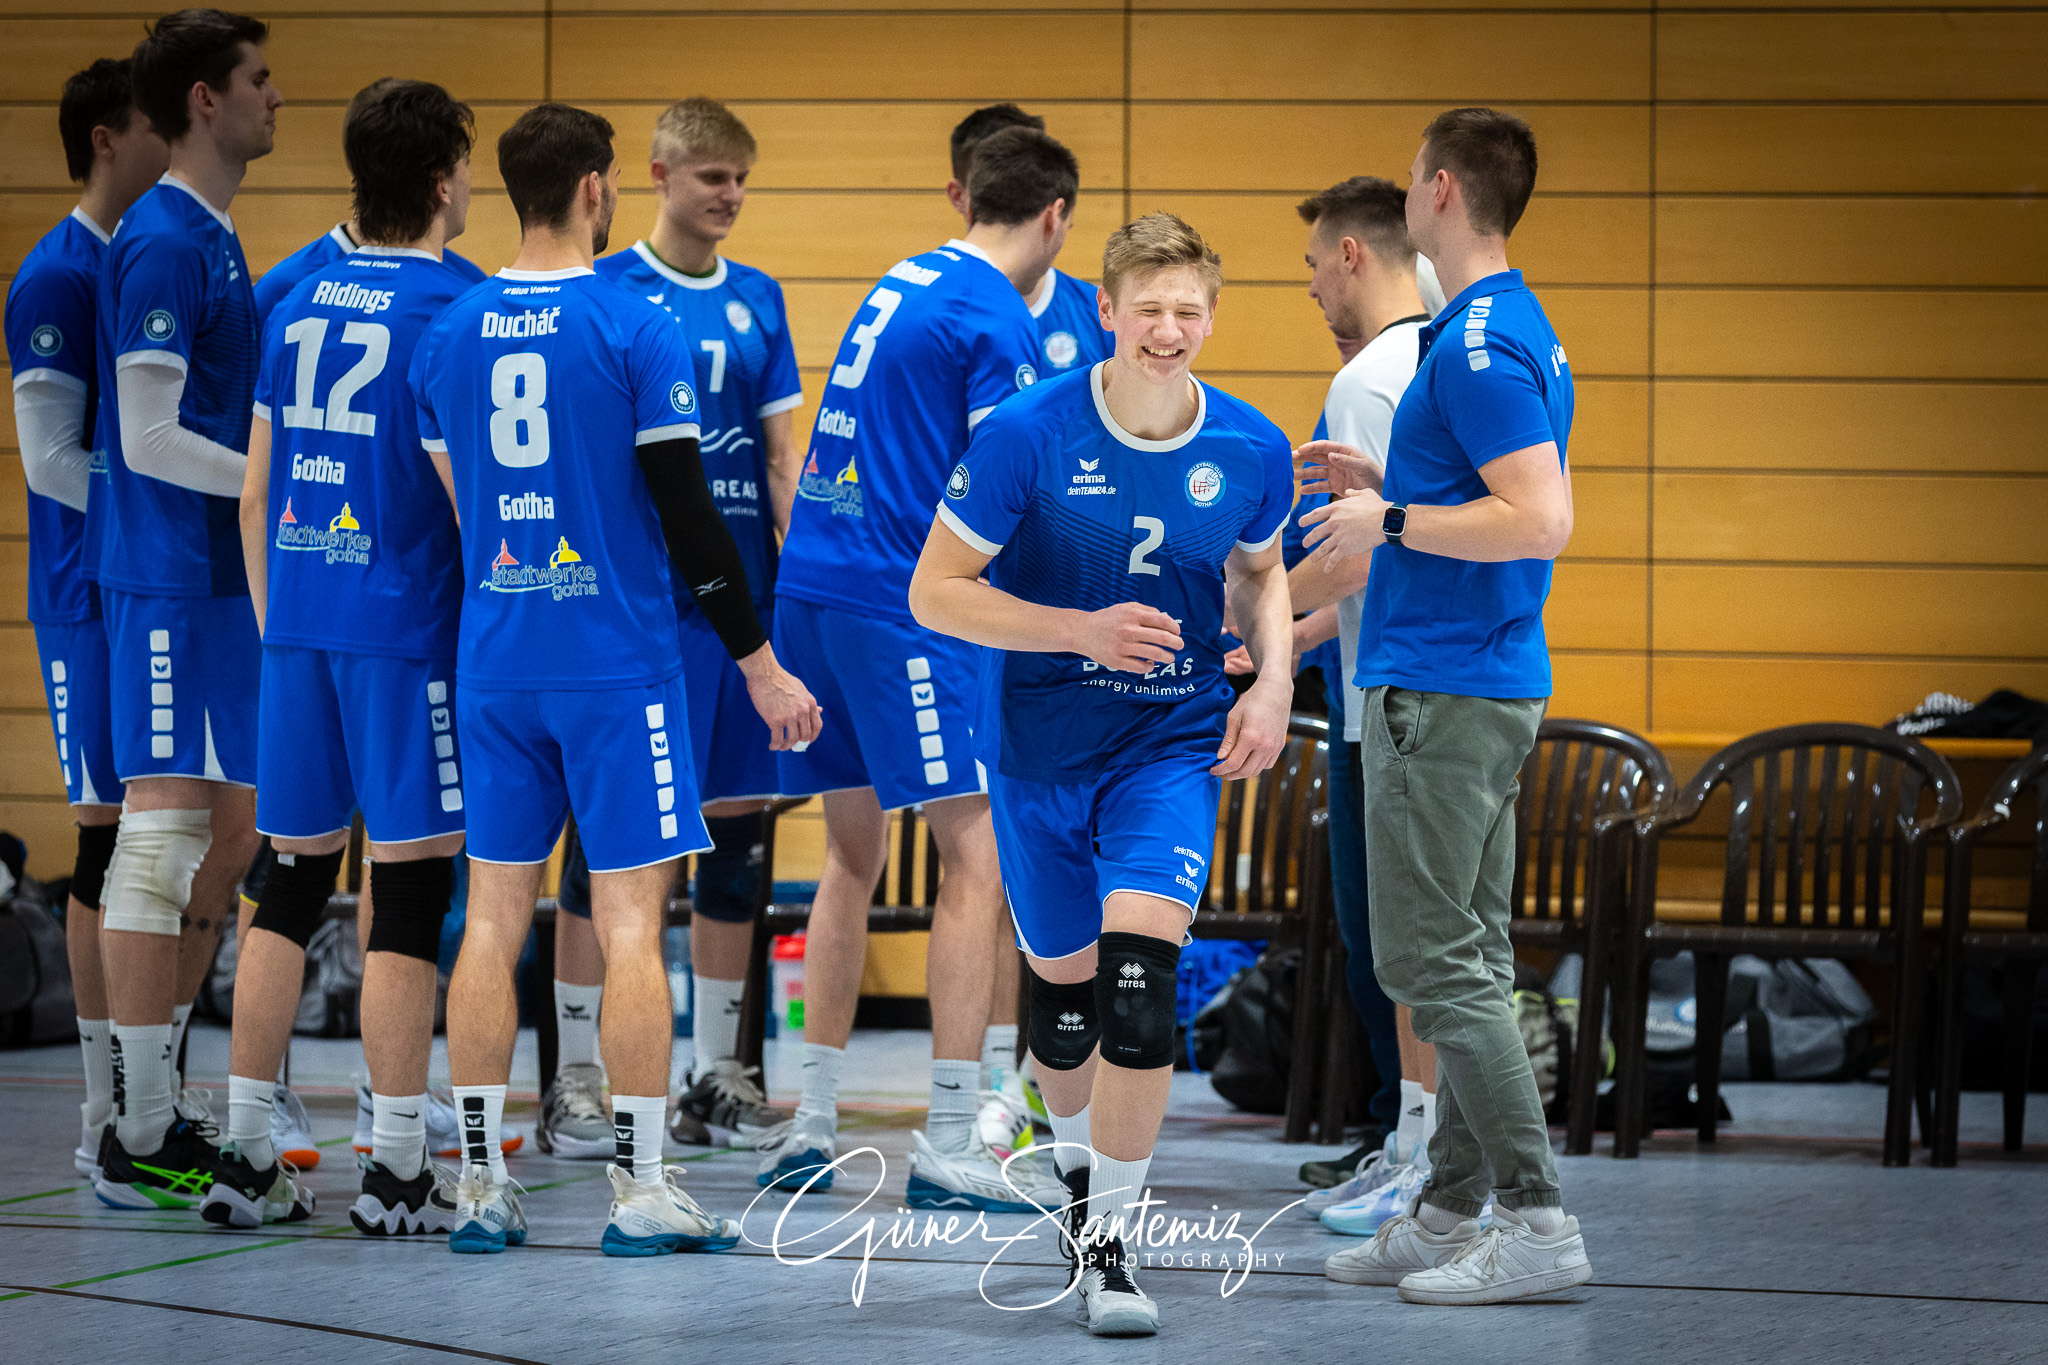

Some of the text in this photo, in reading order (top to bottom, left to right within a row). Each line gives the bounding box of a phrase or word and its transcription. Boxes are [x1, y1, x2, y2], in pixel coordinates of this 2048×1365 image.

[312, 280, 396, 315] Ridings
[481, 306, 562, 339] Ducháč
[830, 286, 903, 390] 3
[281, 316, 392, 437] 12
[700, 339, 727, 393] 7
[489, 352, 550, 468] 8
[818, 406, 857, 440] Gotha
[292, 453, 346, 485] Gotha
[1072, 473, 1106, 484] erima
[1187, 462, 1224, 479] VOLLEYBALL CLUB
[708, 479, 759, 501] REAS
[1067, 485, 1117, 496] deinTEAM24.de
[498, 492, 555, 522] Gotha
[1194, 500, 1213, 508] GOTHA
[325, 548, 370, 566] gotha
[1128, 515, 1166, 577] 2
[492, 562, 598, 587] stadtwerke
[551, 581, 600, 601] gotha
[1082, 657, 1194, 680] BEAS
[1082, 679, 1131, 694] nergy
[1175, 874, 1198, 894] erima
[1117, 979, 1146, 989] errea
[1057, 1023, 1085, 1032] errea
